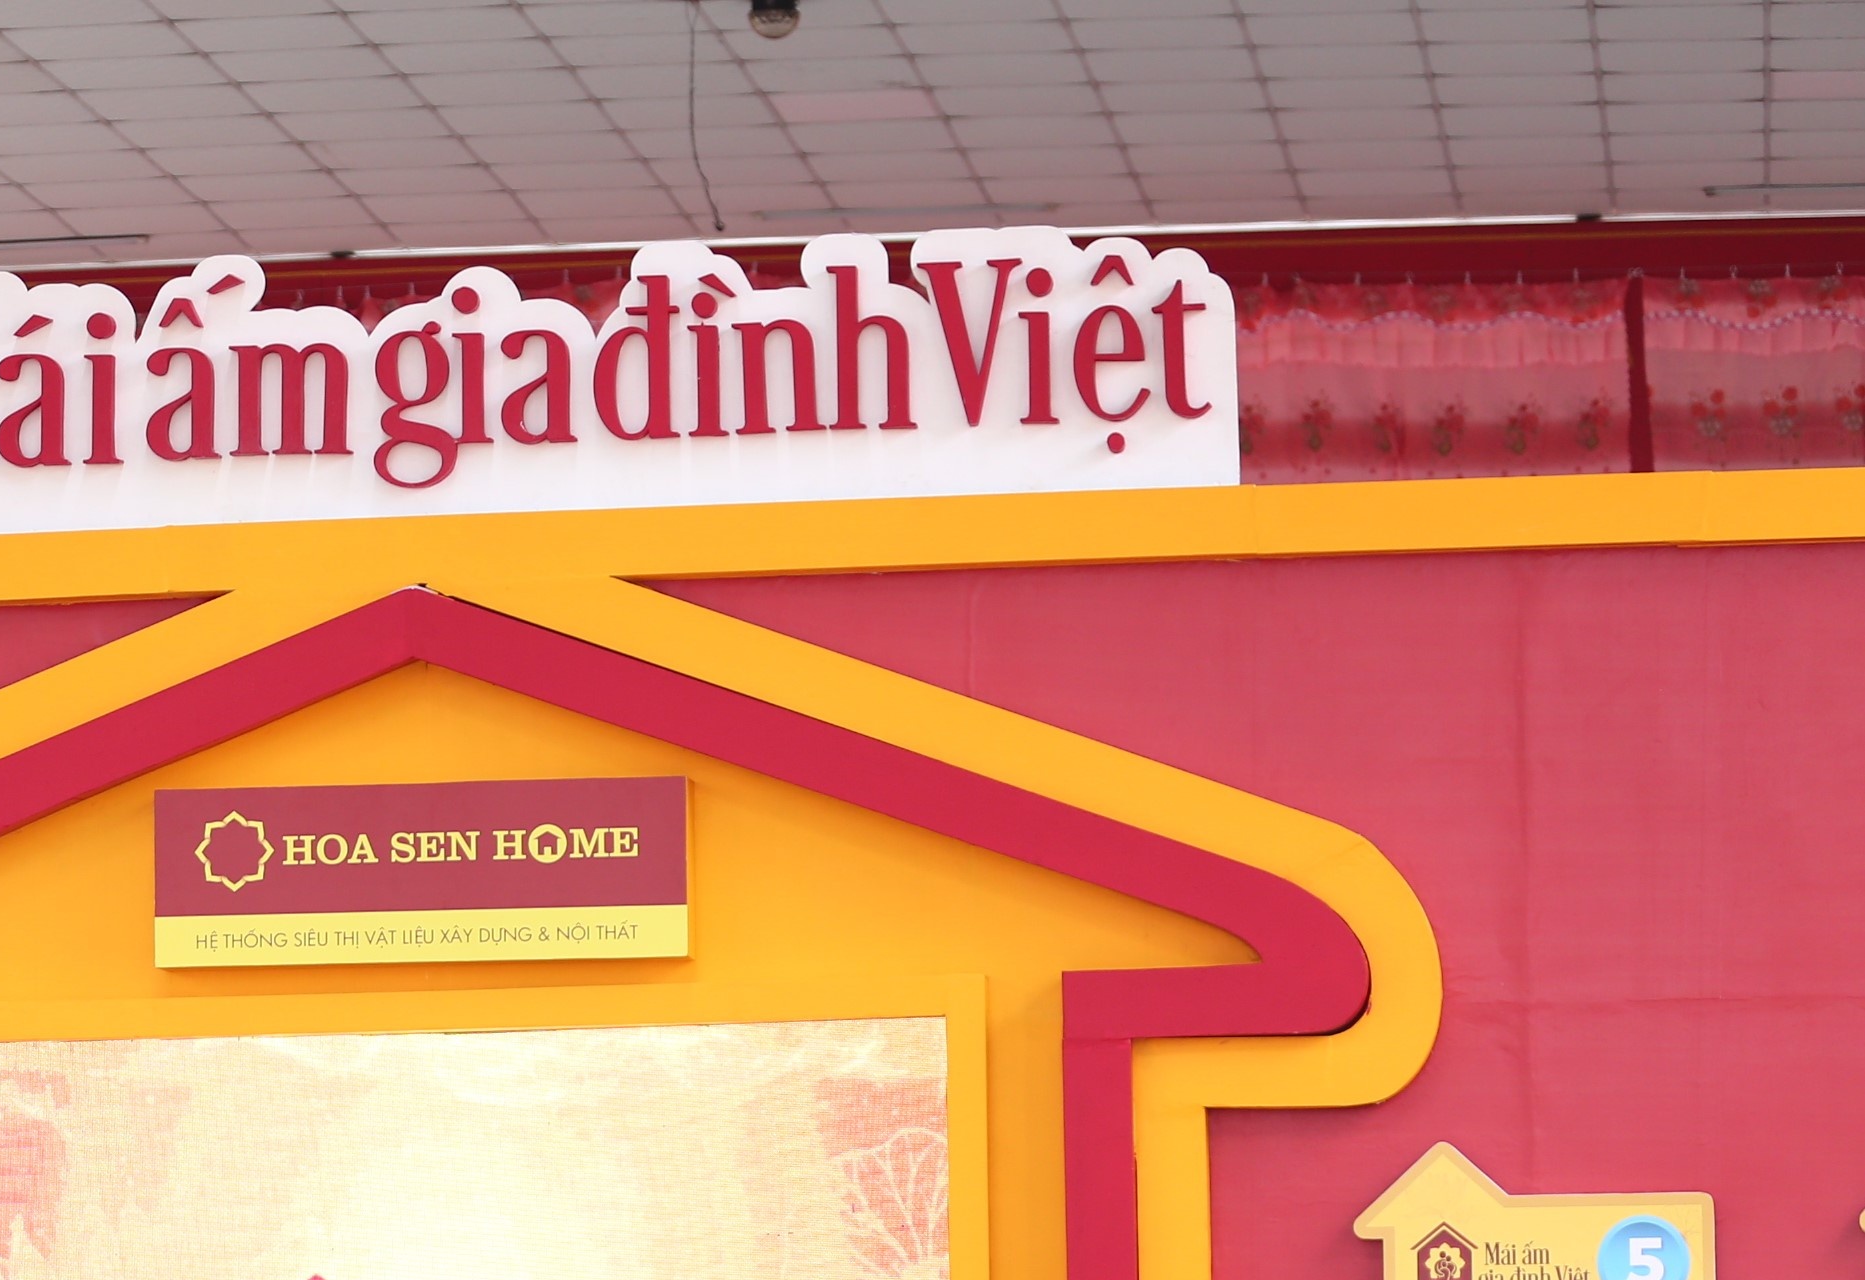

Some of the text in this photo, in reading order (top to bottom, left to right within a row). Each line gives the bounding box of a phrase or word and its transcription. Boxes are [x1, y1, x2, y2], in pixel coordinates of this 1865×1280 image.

[144, 273, 354, 463] ấm
[373, 286, 578, 489] gia
[593, 265, 918, 441] đình
[917, 254, 1213, 455] Việt
[282, 823, 639, 866] HOA SEN HOME
[196, 919, 639, 952] HỆ THỐNG SIÊU THỊ VẬT LIỆU XÂY DỰNG & NỘI THẤT
[1484, 1240, 1550, 1266] Mái ấm
